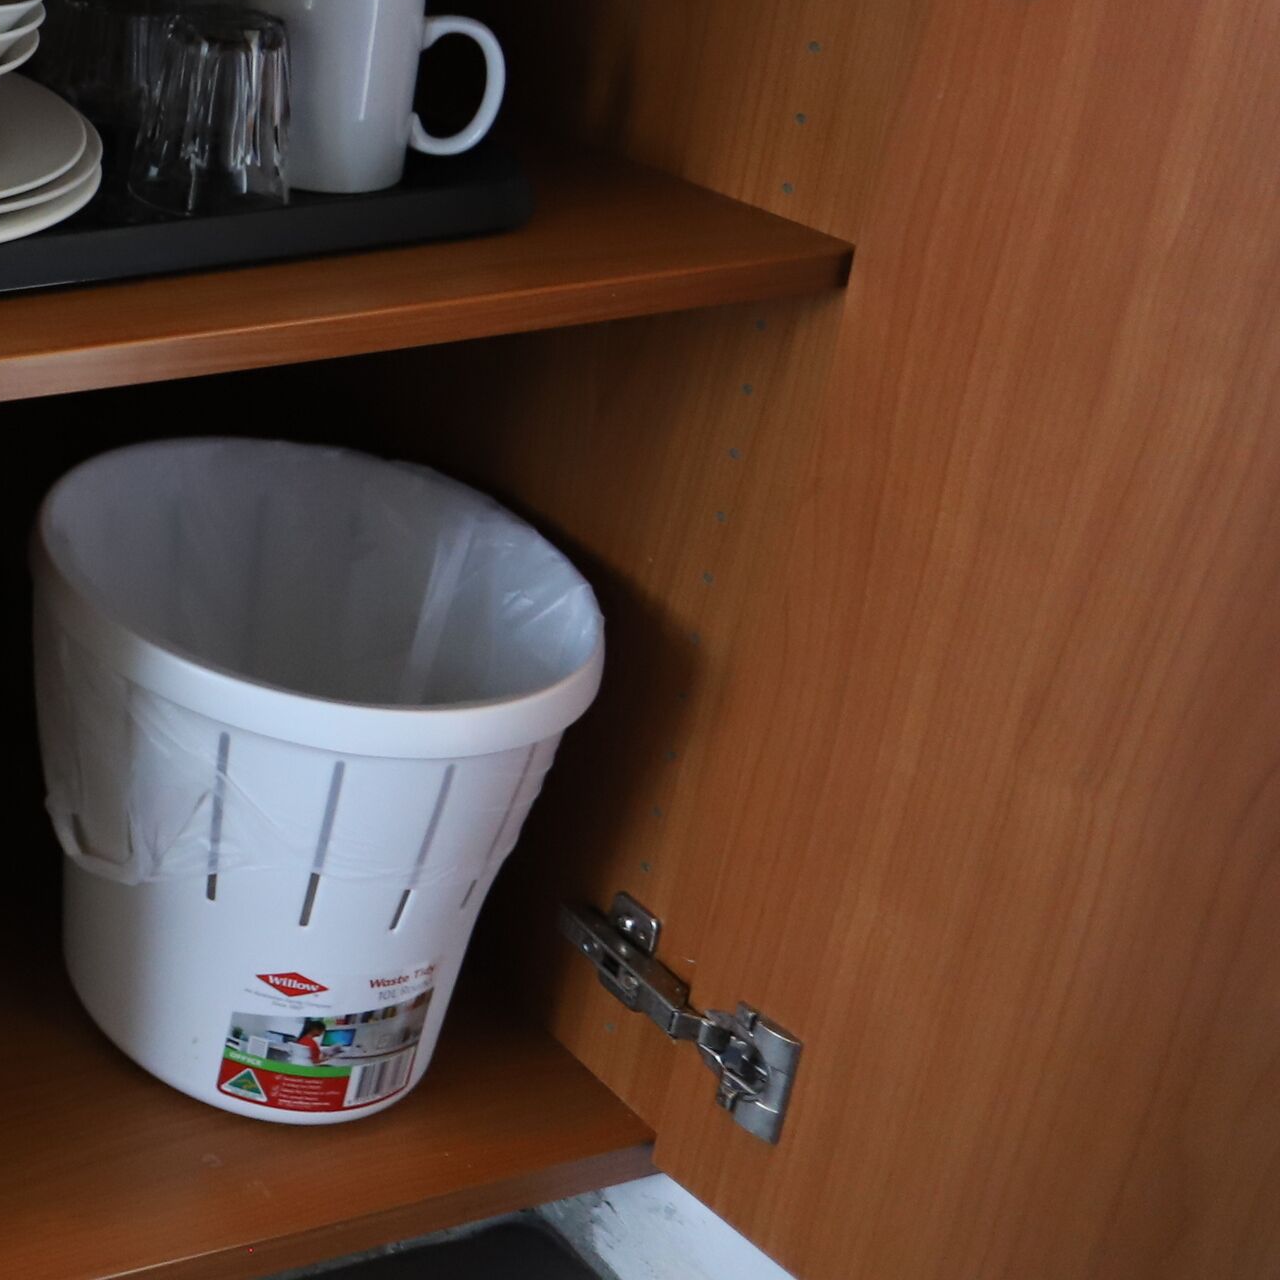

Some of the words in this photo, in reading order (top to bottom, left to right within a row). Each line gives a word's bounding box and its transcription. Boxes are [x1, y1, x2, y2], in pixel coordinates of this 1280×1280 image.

[268, 975, 320, 991] Willow
[369, 975, 409, 988] Waste
[228, 1050, 262, 1065] OFFICE
